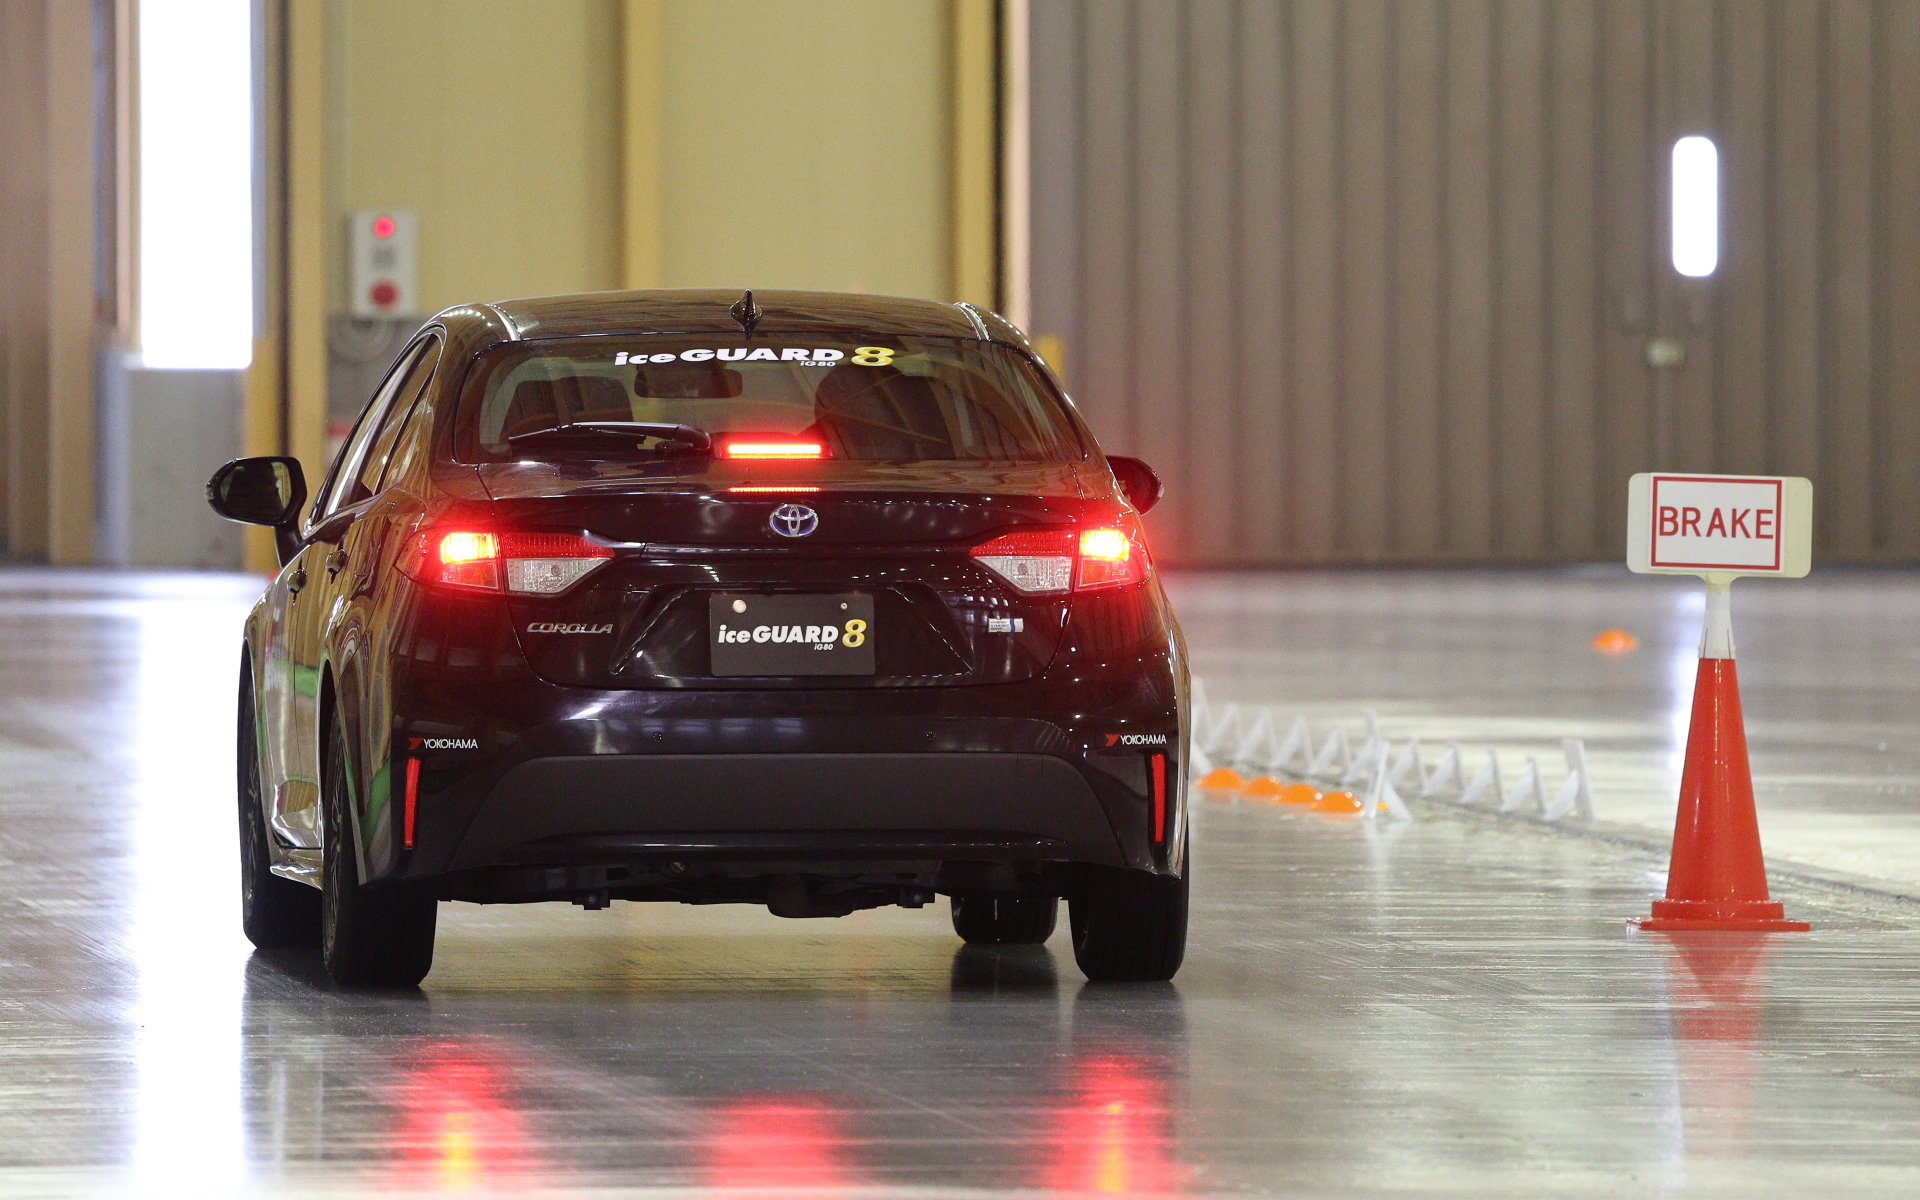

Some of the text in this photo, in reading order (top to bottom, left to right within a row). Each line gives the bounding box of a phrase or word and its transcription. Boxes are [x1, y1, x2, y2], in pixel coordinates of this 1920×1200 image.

[614, 346, 895, 367] iceGUARD 8
[1658, 506, 1774, 539] BRAKE
[526, 622, 614, 634] COROLLA
[717, 619, 867, 648] iceGUARD 8
[423, 738, 479, 749] YOKOHAMA
[1120, 734, 1167, 745] YOKOHAMA
